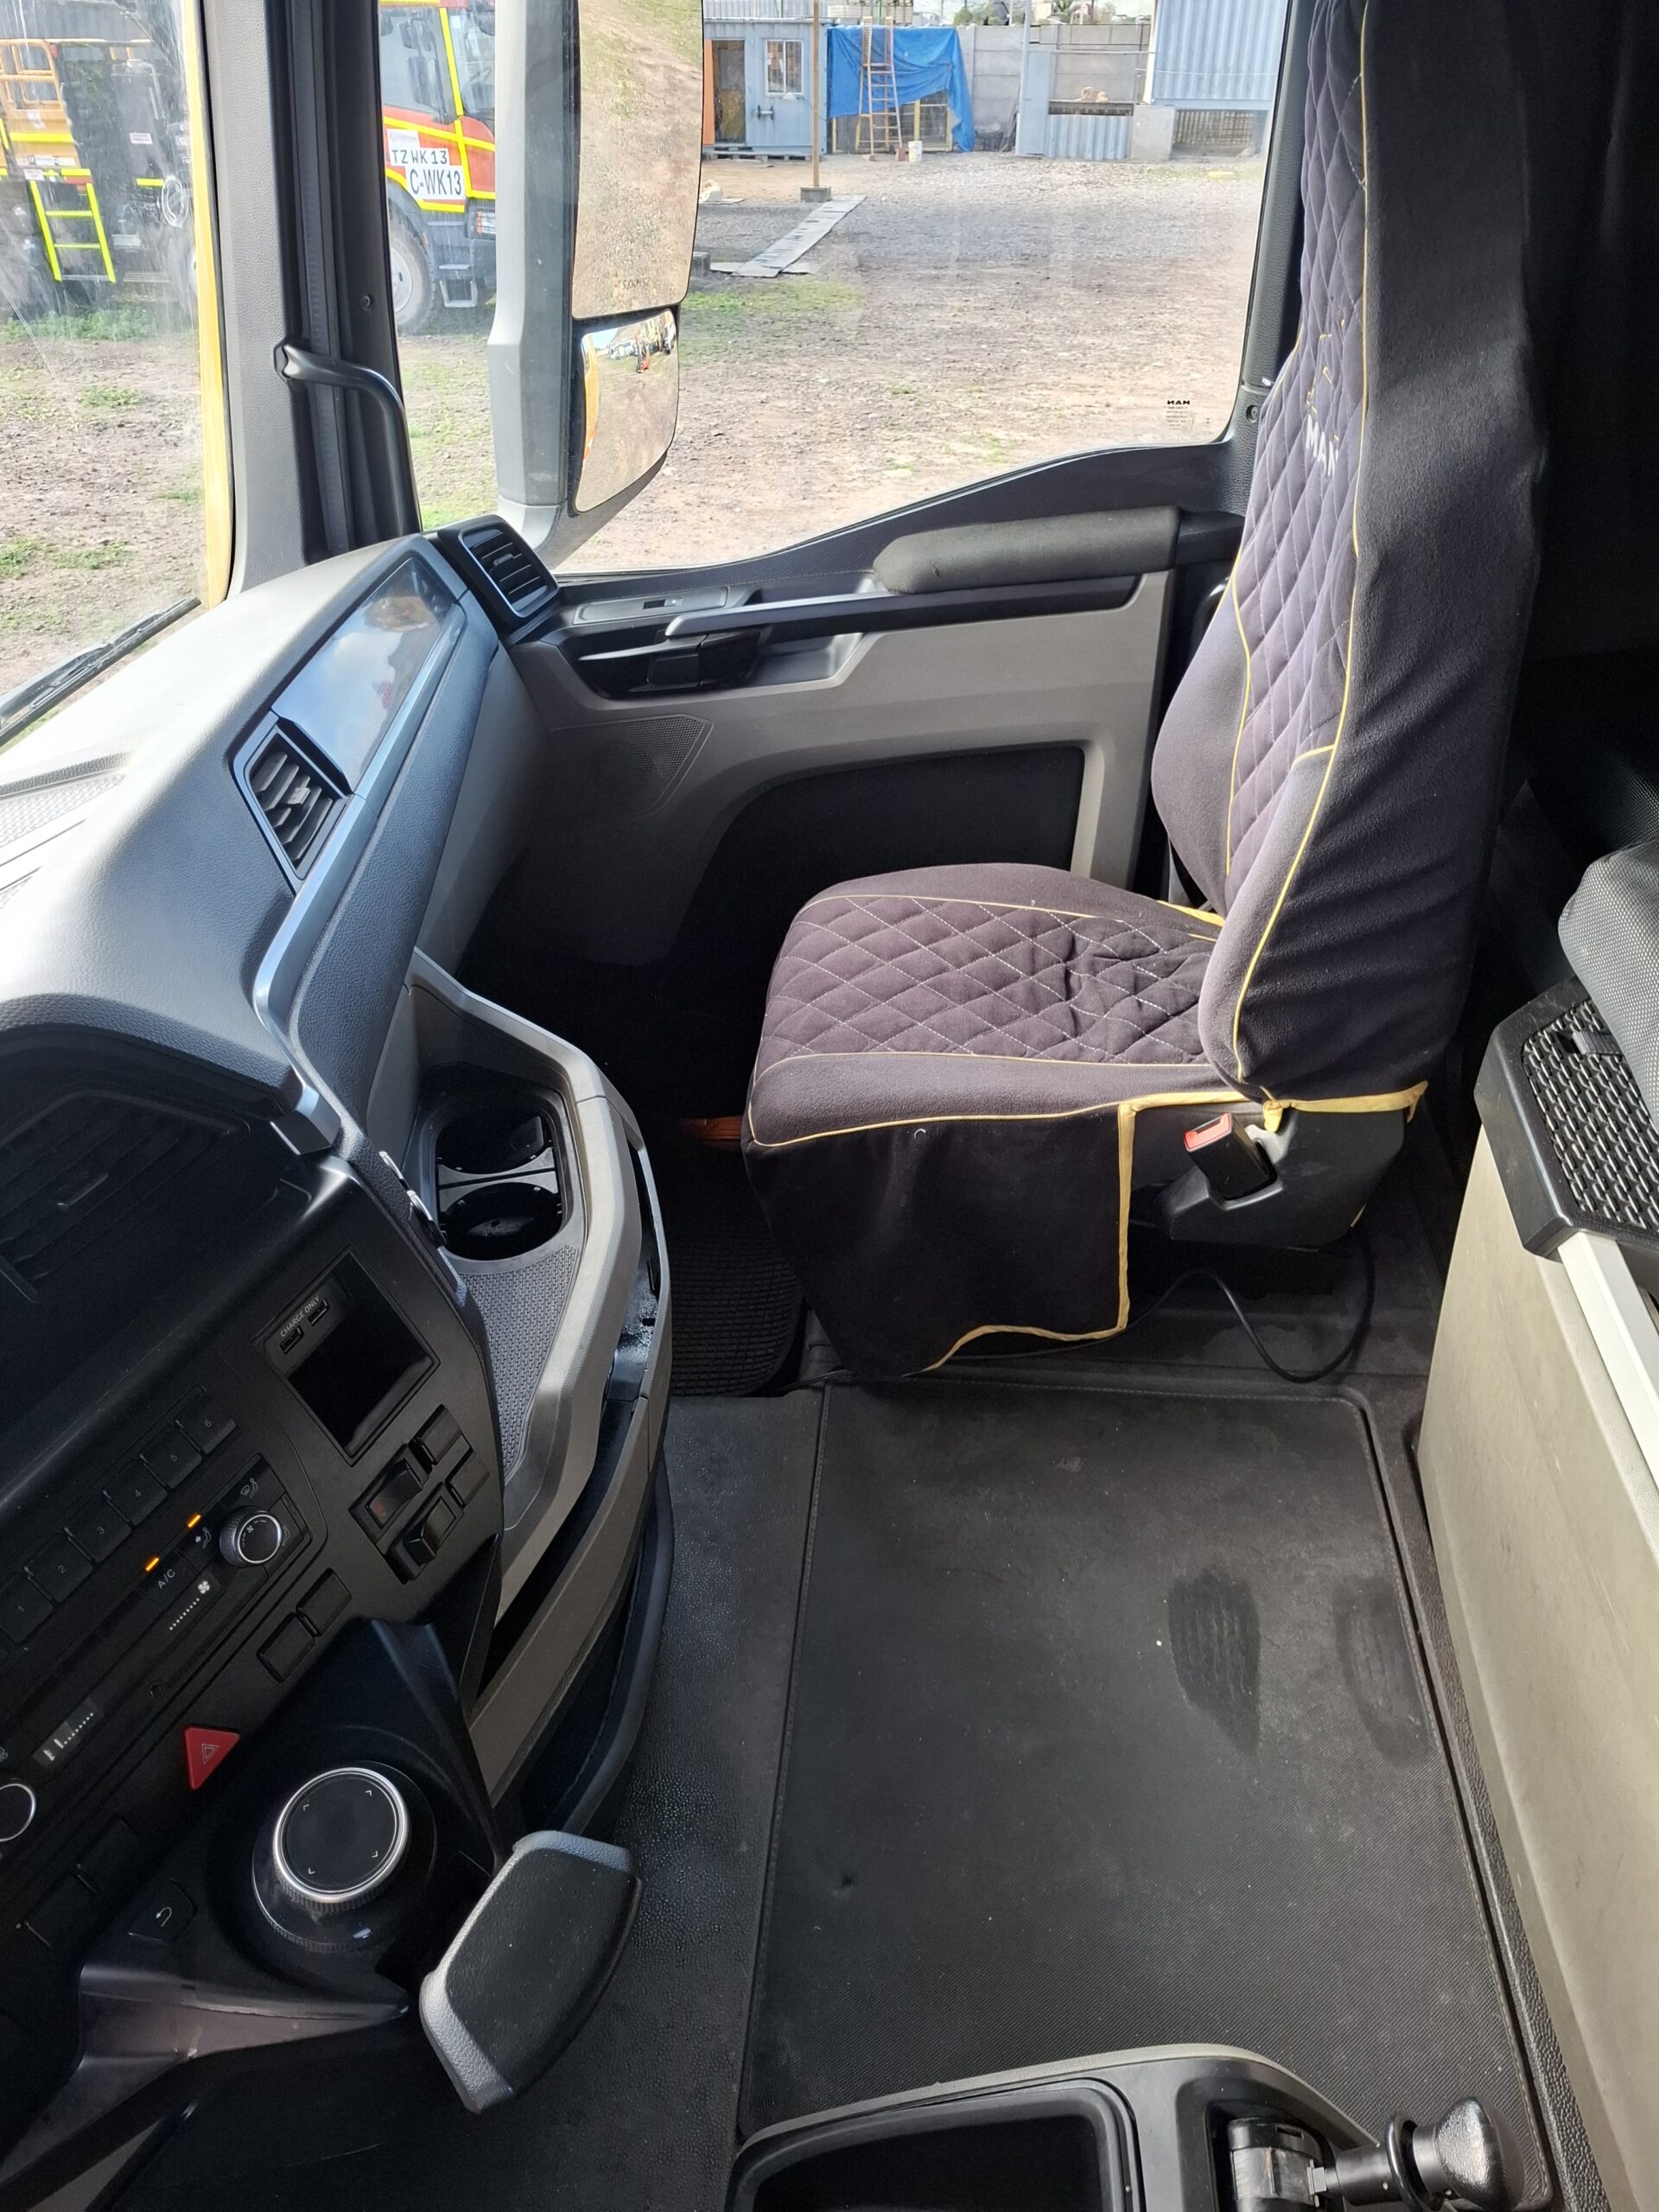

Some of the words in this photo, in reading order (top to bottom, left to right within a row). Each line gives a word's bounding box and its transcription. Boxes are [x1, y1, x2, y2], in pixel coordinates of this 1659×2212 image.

[410, 168, 462, 195] C-WK13
[280, 1311, 305, 1338] CHARGE
[304, 1295, 320, 1313] ONLY
[158, 1568, 175, 1589] A/C
